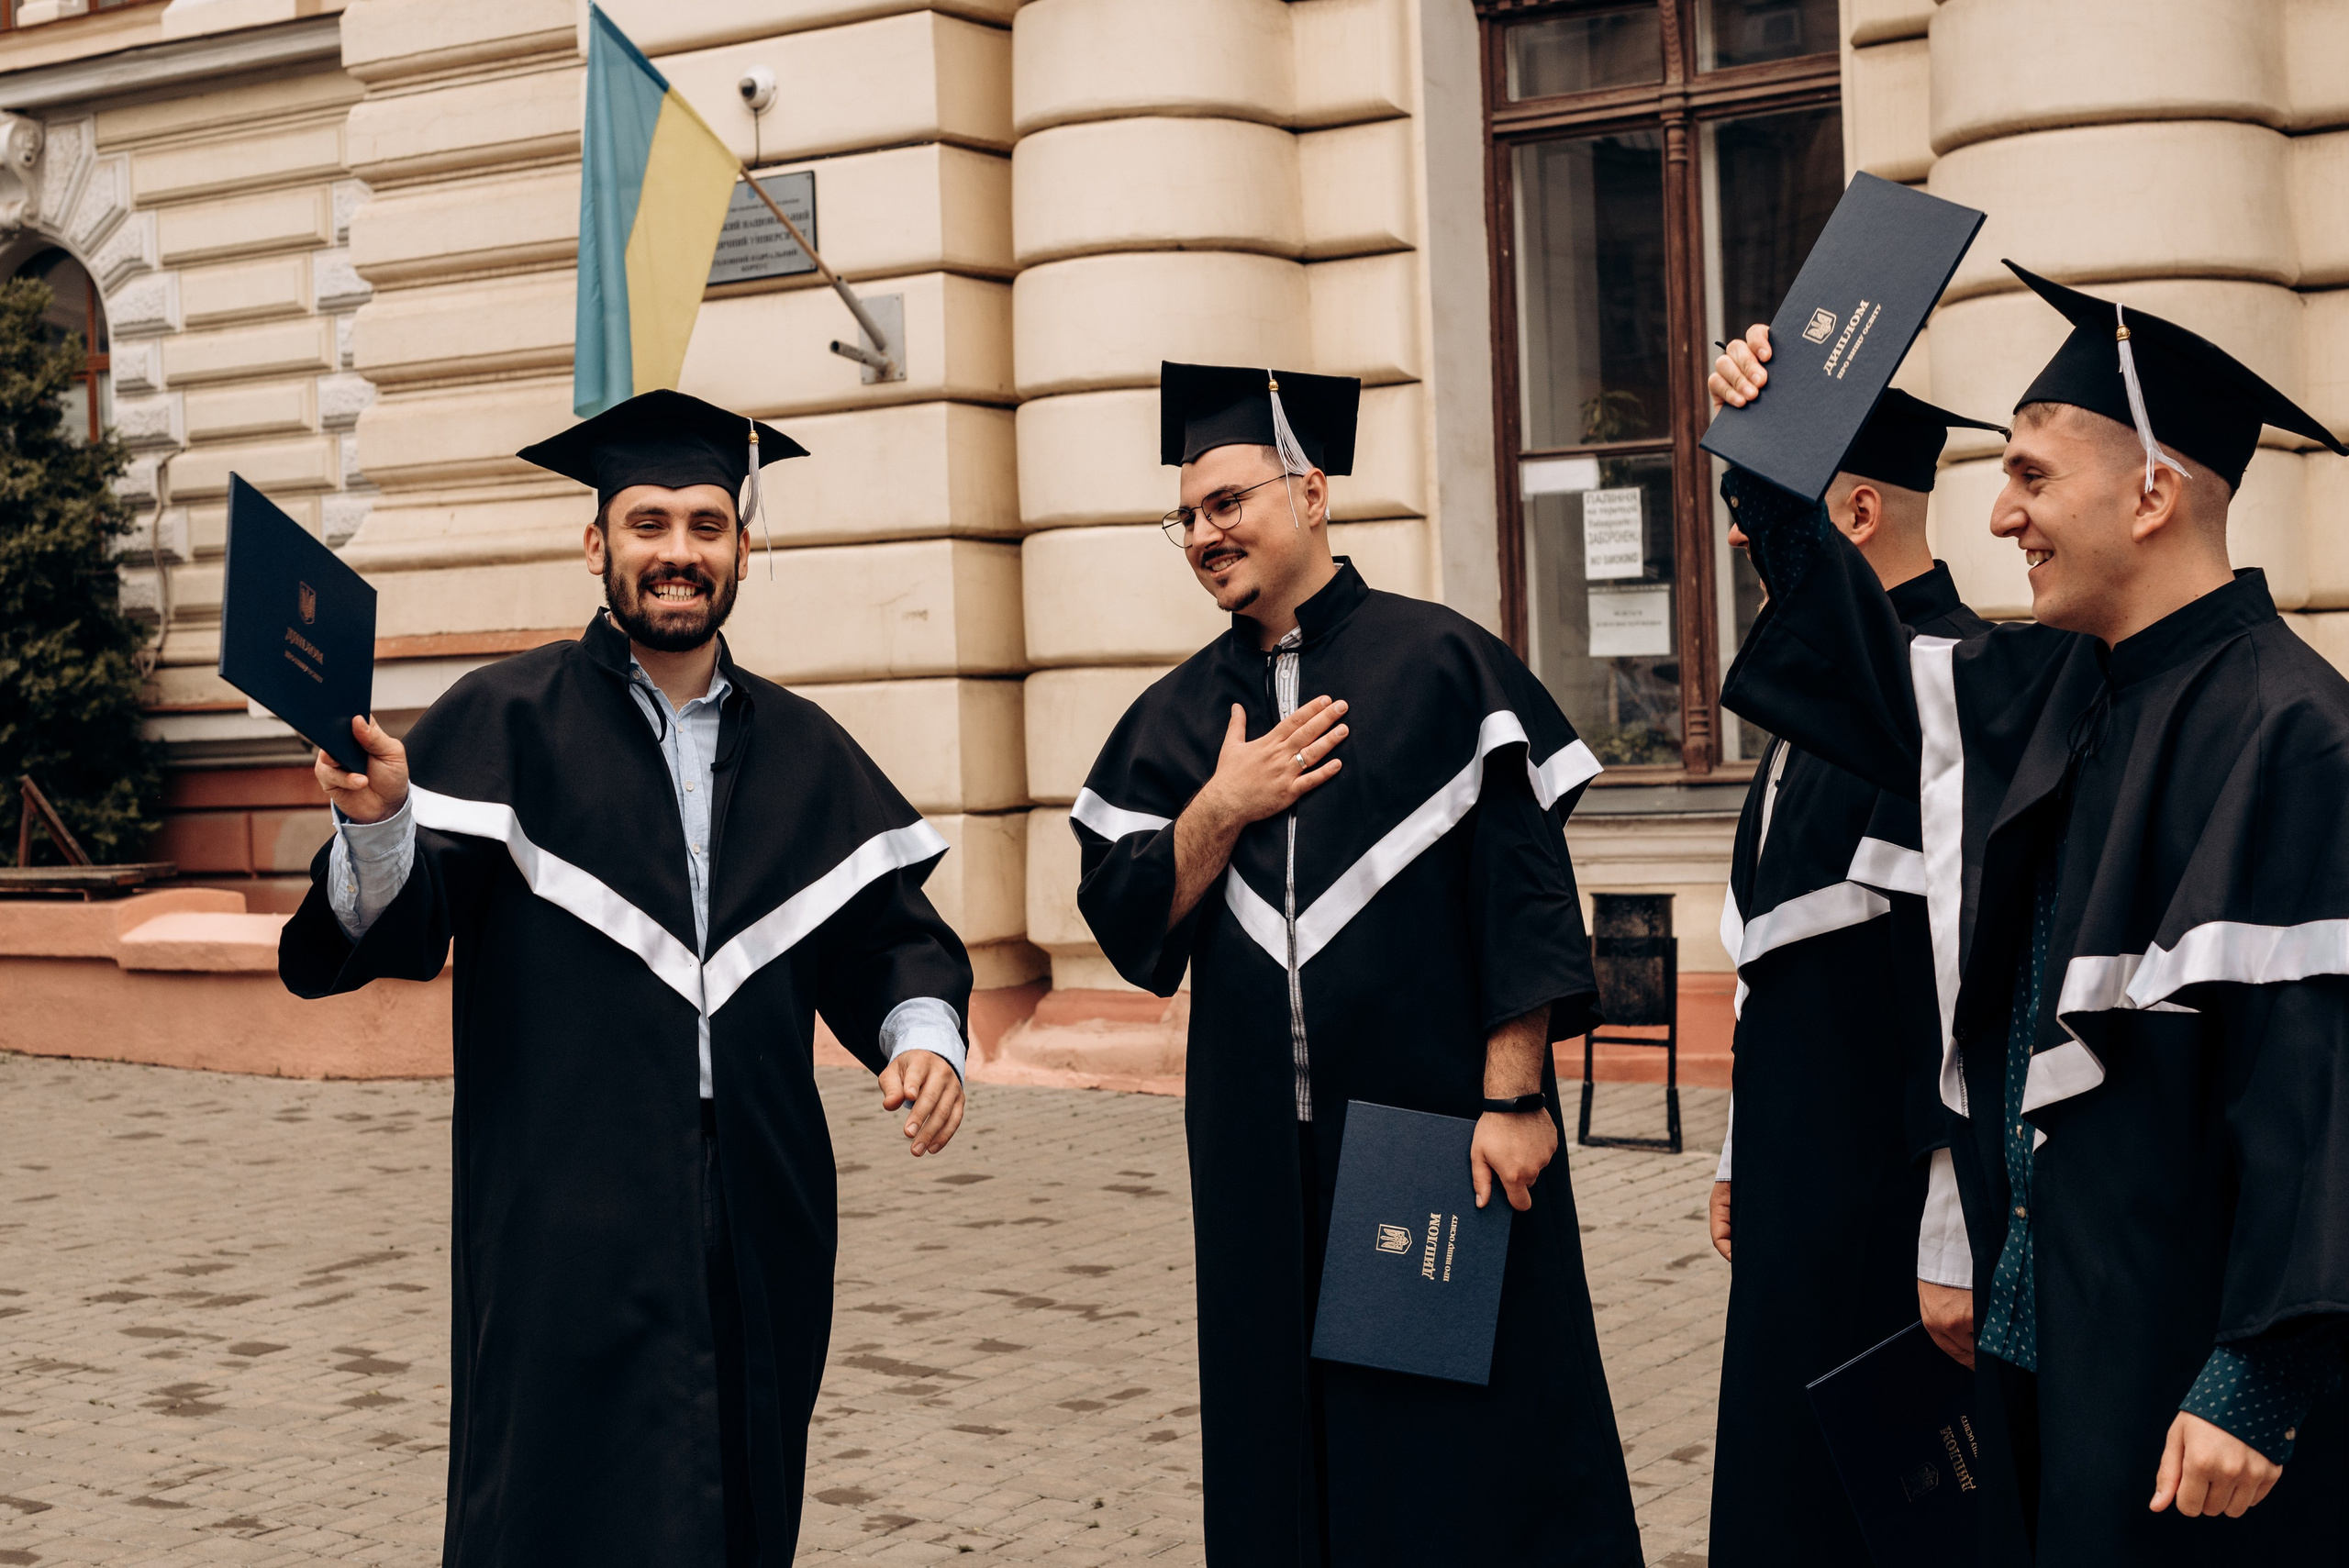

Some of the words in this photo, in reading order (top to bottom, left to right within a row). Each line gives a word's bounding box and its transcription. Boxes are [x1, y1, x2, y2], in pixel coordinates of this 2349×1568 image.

[1823, 299, 1870, 376] ДИПЛОМ
[1836, 361, 1850, 380] ПРО
[1863, 303, 1882, 335] ОСВІТУ
[1421, 1212, 1442, 1280] ДИПЛОМ
[1449, 1214, 1458, 1242] ОСВІТУ
[1442, 1265, 1451, 1282] ПРО
[1445, 1241, 1455, 1266] ВИЩУ
[1960, 1416, 1975, 1441] ОСВІТУ
[1940, 1425, 1976, 1492] ДИПЛОМ
